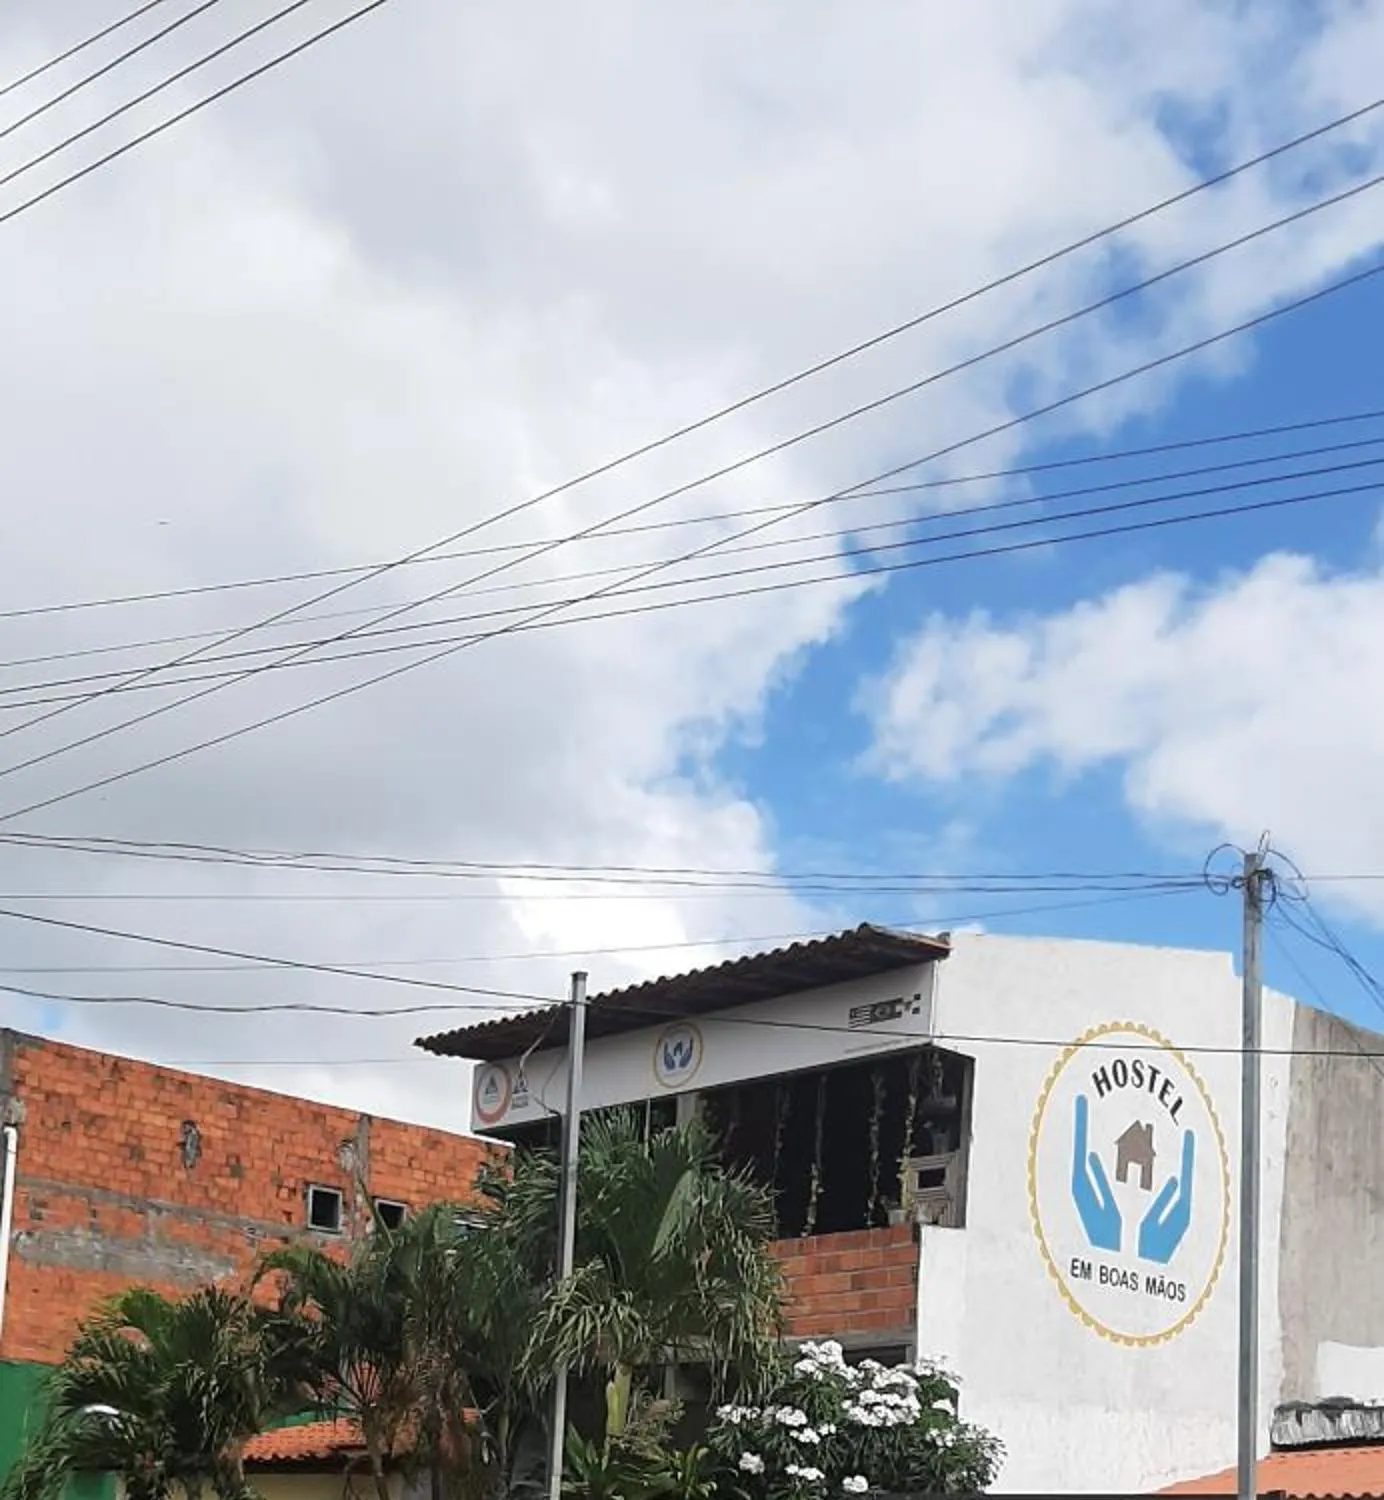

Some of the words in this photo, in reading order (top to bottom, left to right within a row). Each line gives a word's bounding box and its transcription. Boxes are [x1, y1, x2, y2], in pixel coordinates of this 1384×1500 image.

[1092, 1059, 1183, 1127] HOSTEL
[1070, 1258, 1092, 1280] EM
[1099, 1265, 1139, 1291] BOAS
[1145, 1275, 1186, 1302] MÃOS
